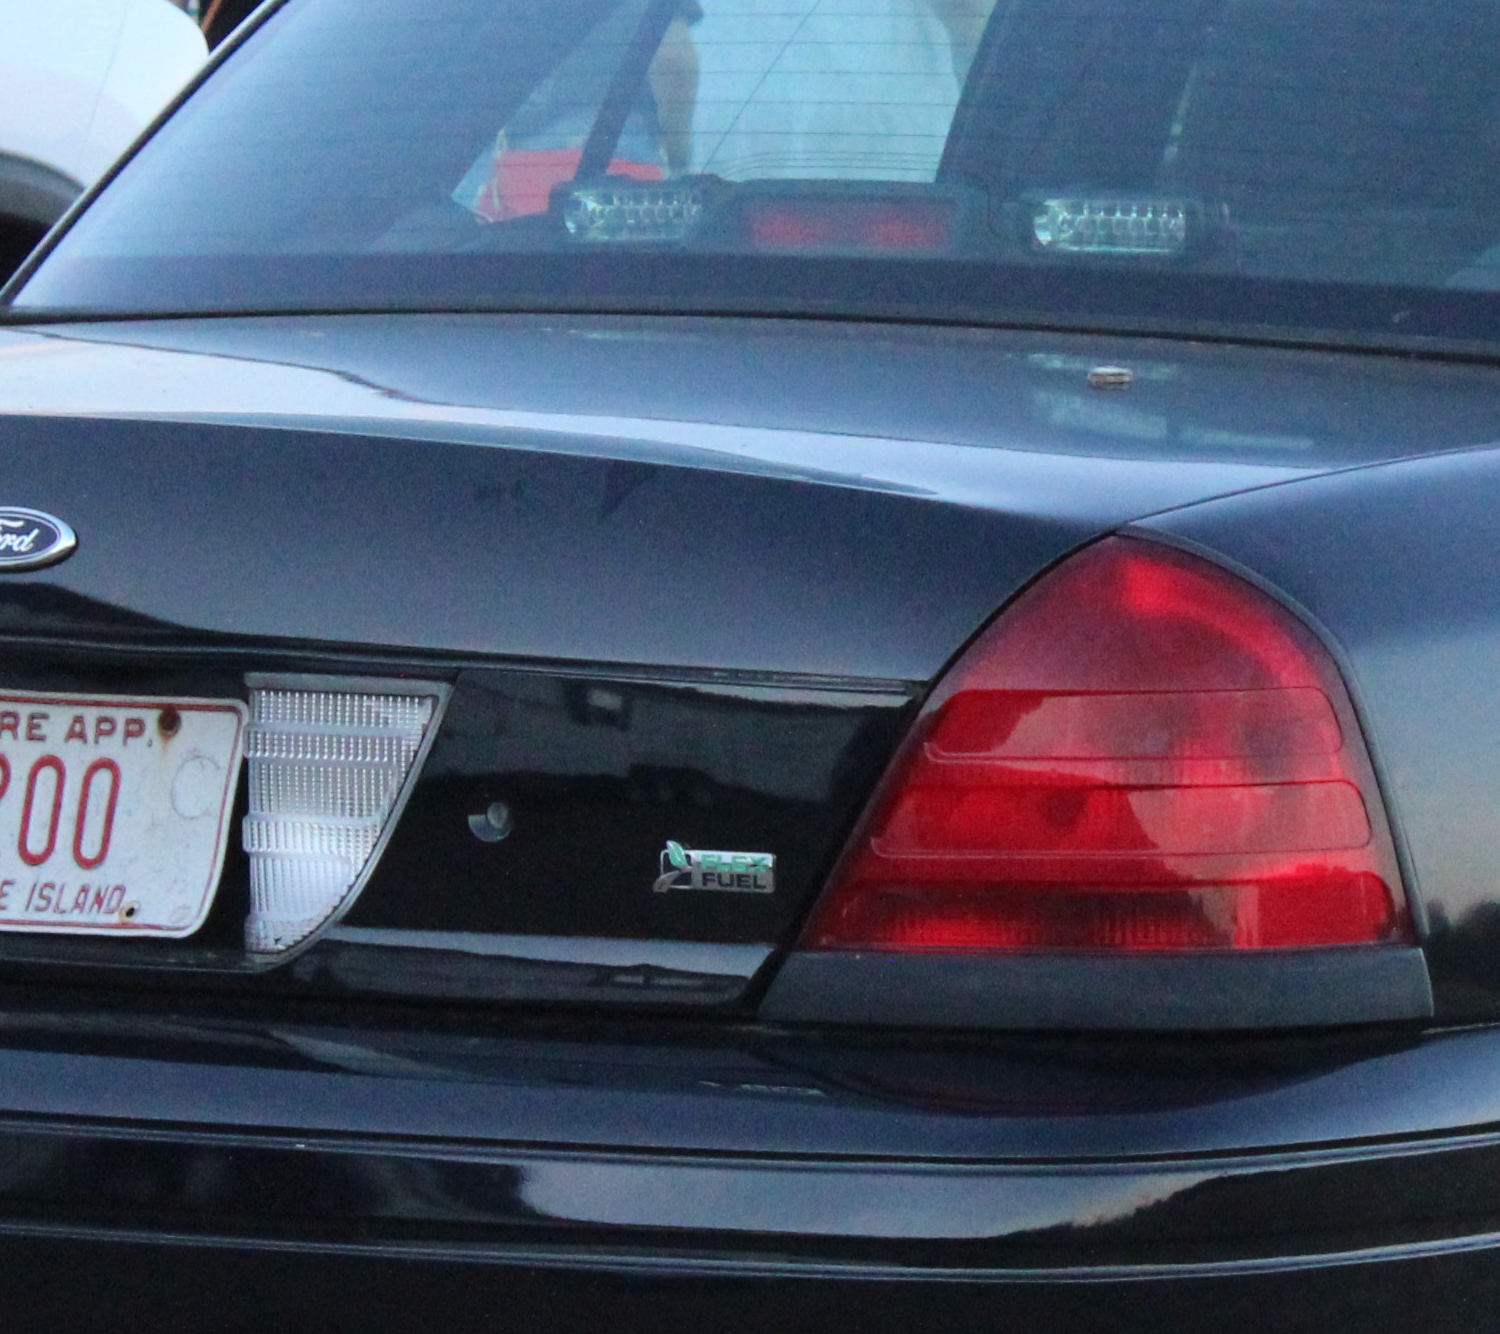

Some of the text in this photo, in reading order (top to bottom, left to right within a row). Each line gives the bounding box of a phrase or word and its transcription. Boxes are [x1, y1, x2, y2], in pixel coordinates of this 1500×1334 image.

[700, 854, 768, 873] FLEX
[701, 872, 768, 890] FUEL
[23, 881, 127, 916] ISLAND
